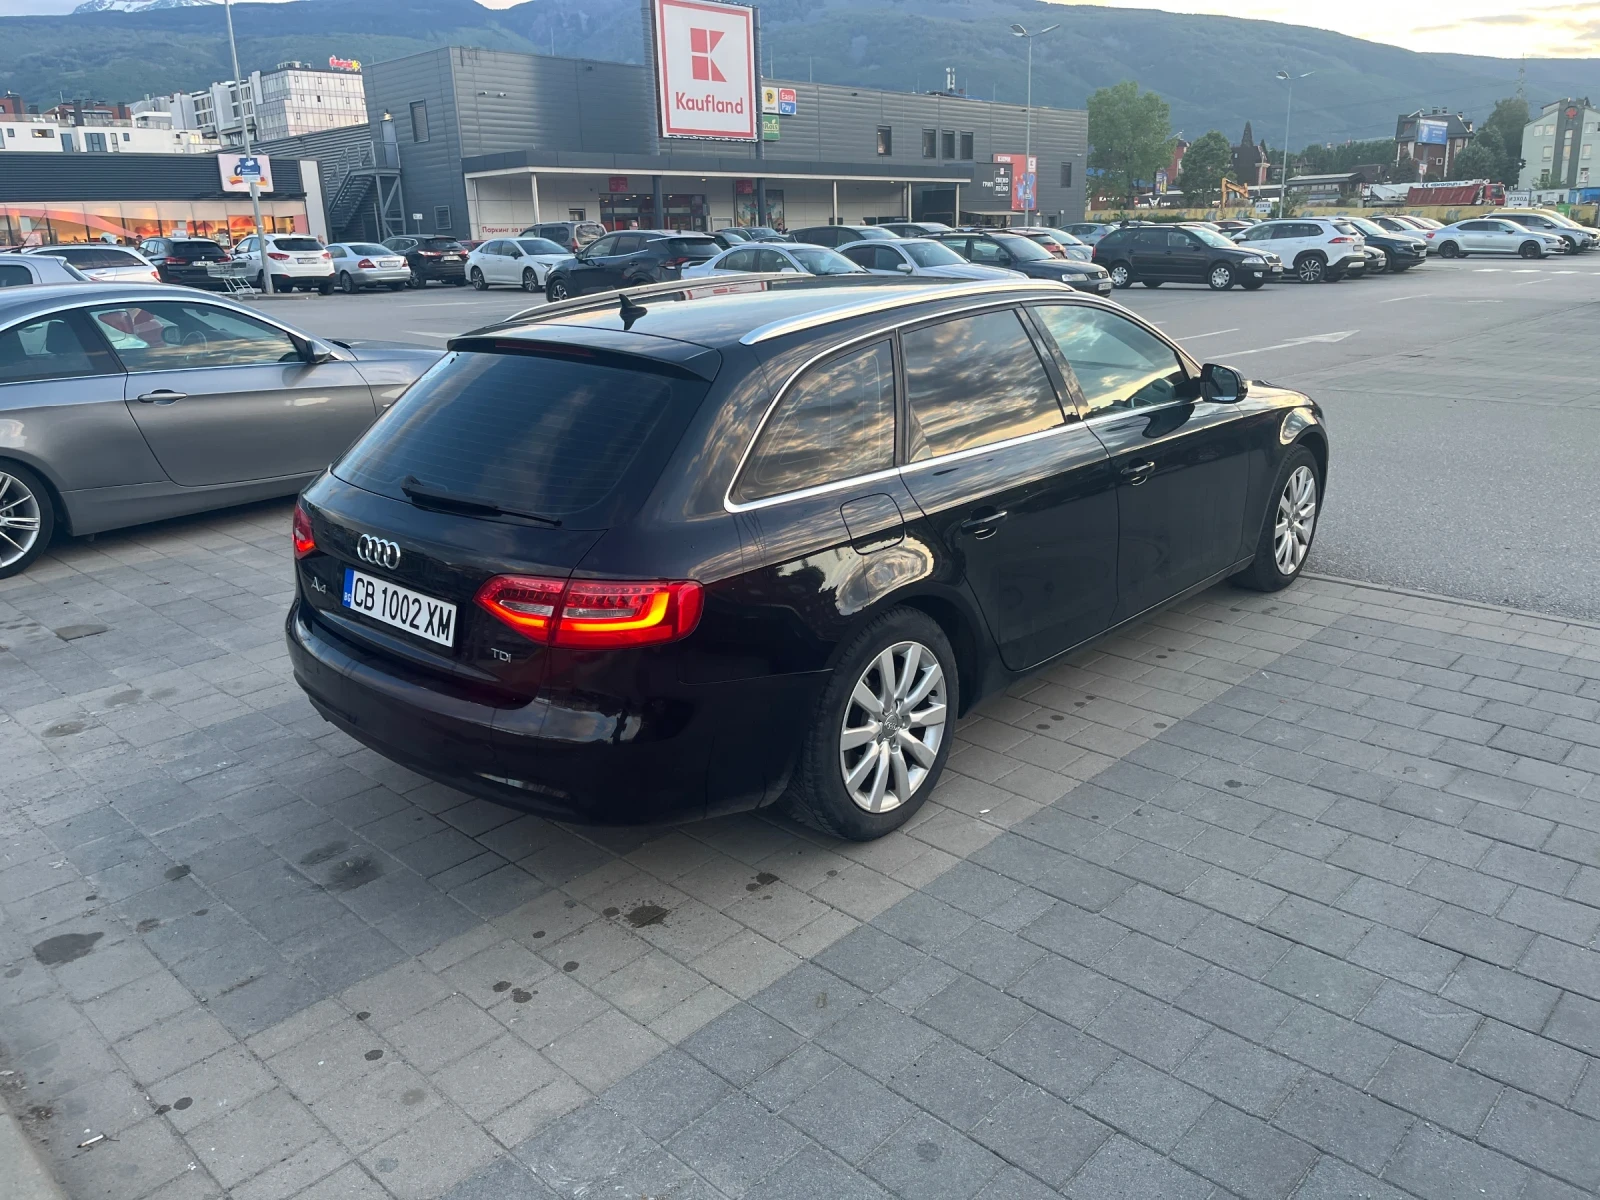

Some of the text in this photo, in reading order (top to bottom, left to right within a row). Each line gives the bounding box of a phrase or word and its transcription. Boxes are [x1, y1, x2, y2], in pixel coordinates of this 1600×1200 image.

[676, 91, 743, 114] Kaufland
[781, 92, 794, 102] Easy
[781, 102, 792, 113] Pay
[482, 226, 509, 234] Паркинг
[354, 577, 453, 641] CB 1002 XM
[490, 647, 512, 663] TDI
